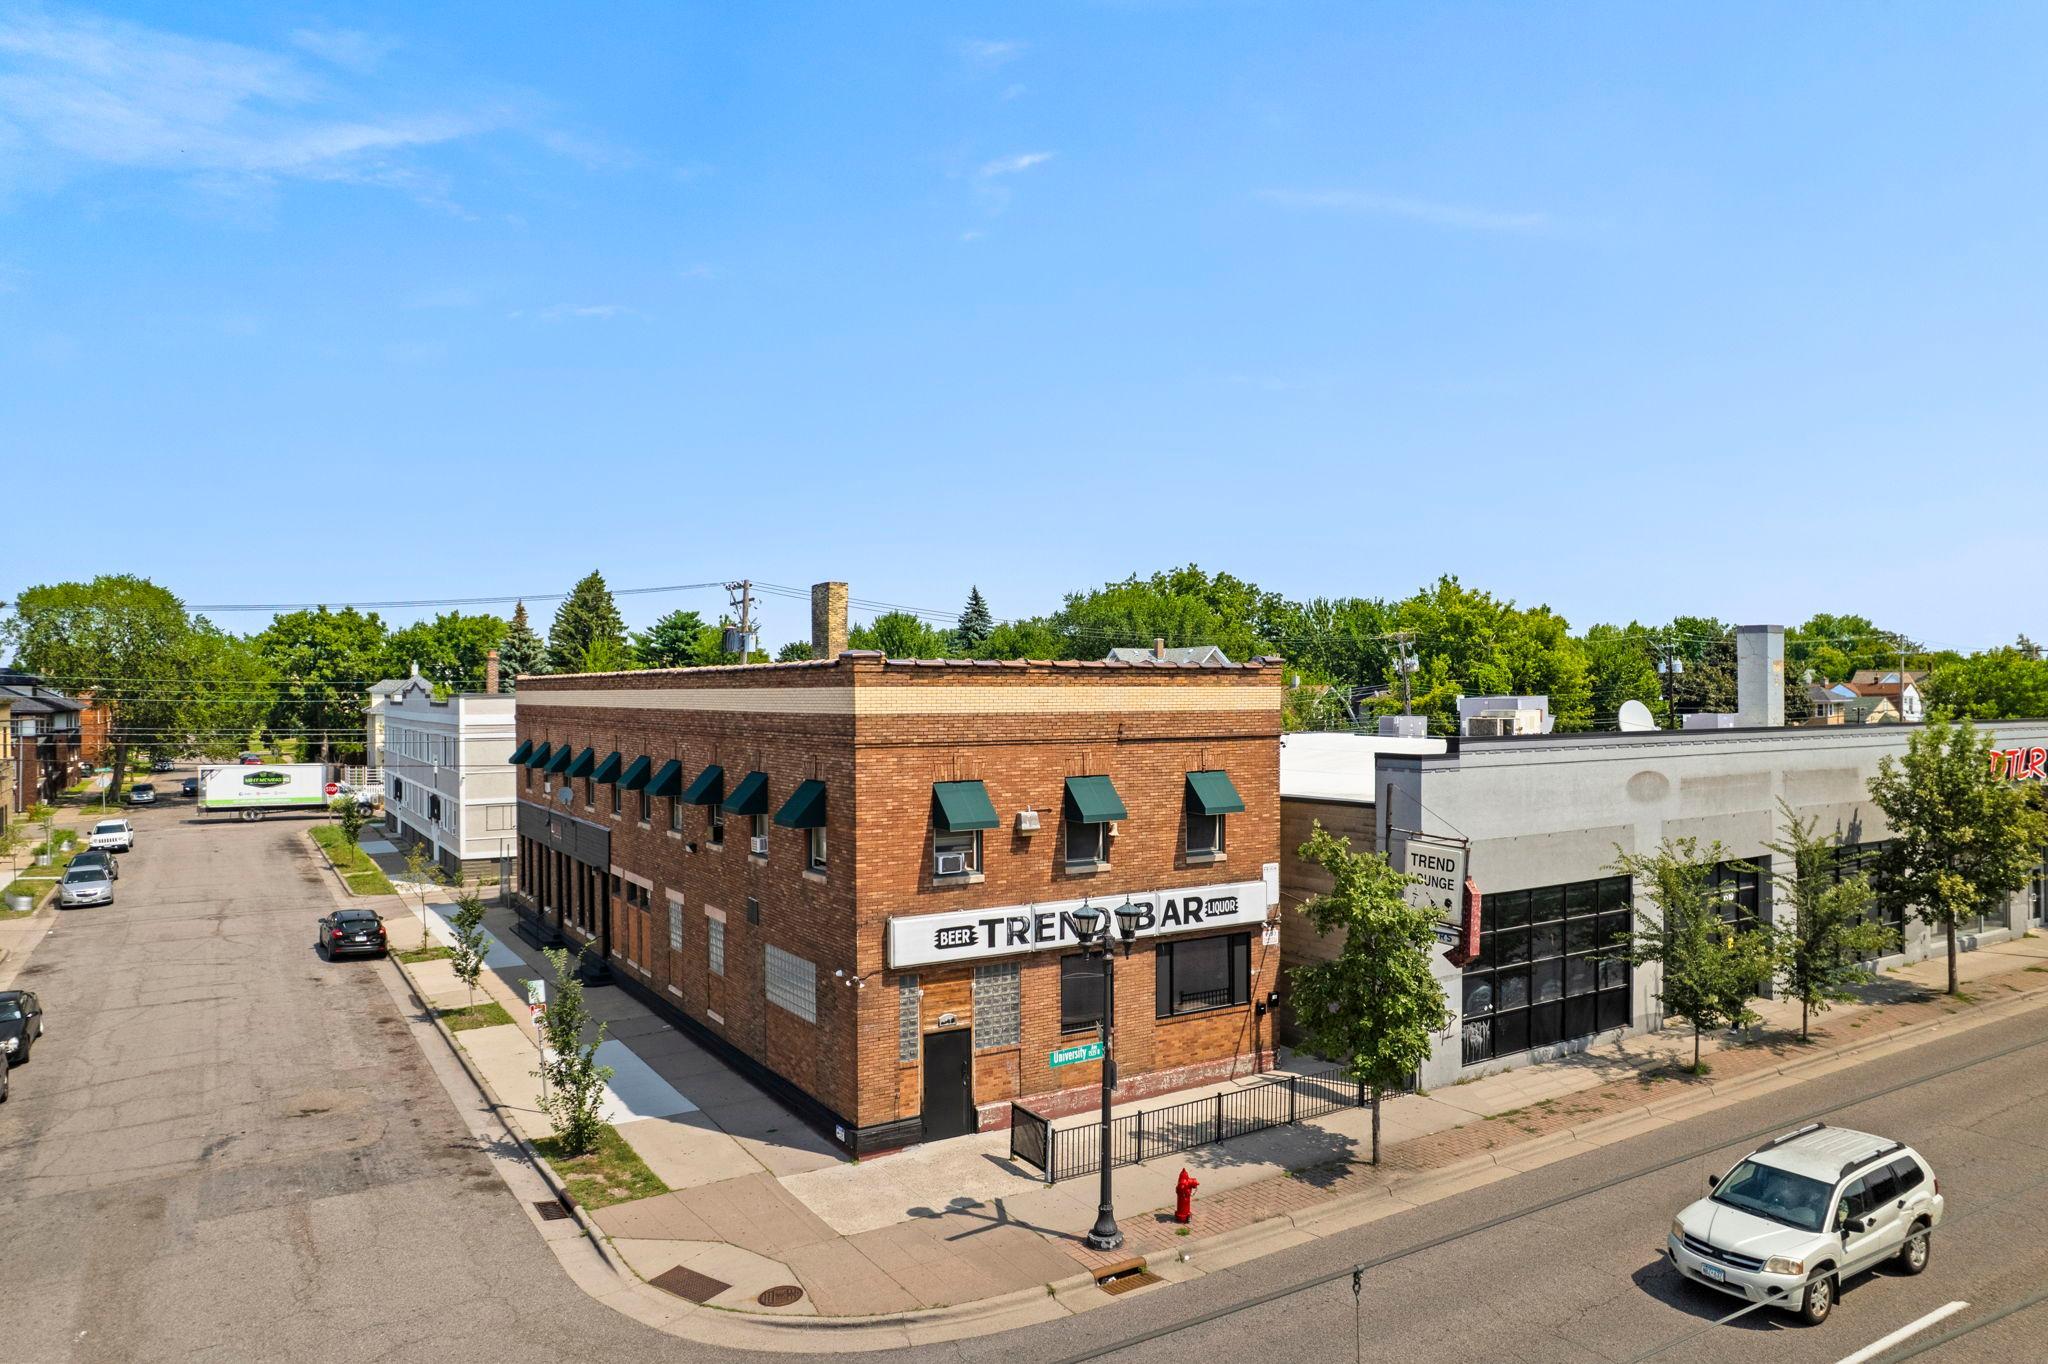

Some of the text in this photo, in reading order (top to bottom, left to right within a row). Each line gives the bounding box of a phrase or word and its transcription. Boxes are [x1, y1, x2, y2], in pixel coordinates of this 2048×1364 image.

[1411, 853, 1455, 873] TREND
[1410, 872, 1455, 891] OUNGE
[940, 929, 970, 946] BEER
[1133, 896, 1204, 931] BAR
[1208, 899, 1236, 916] LIQUOR
[1053, 1047, 1087, 1064] University
